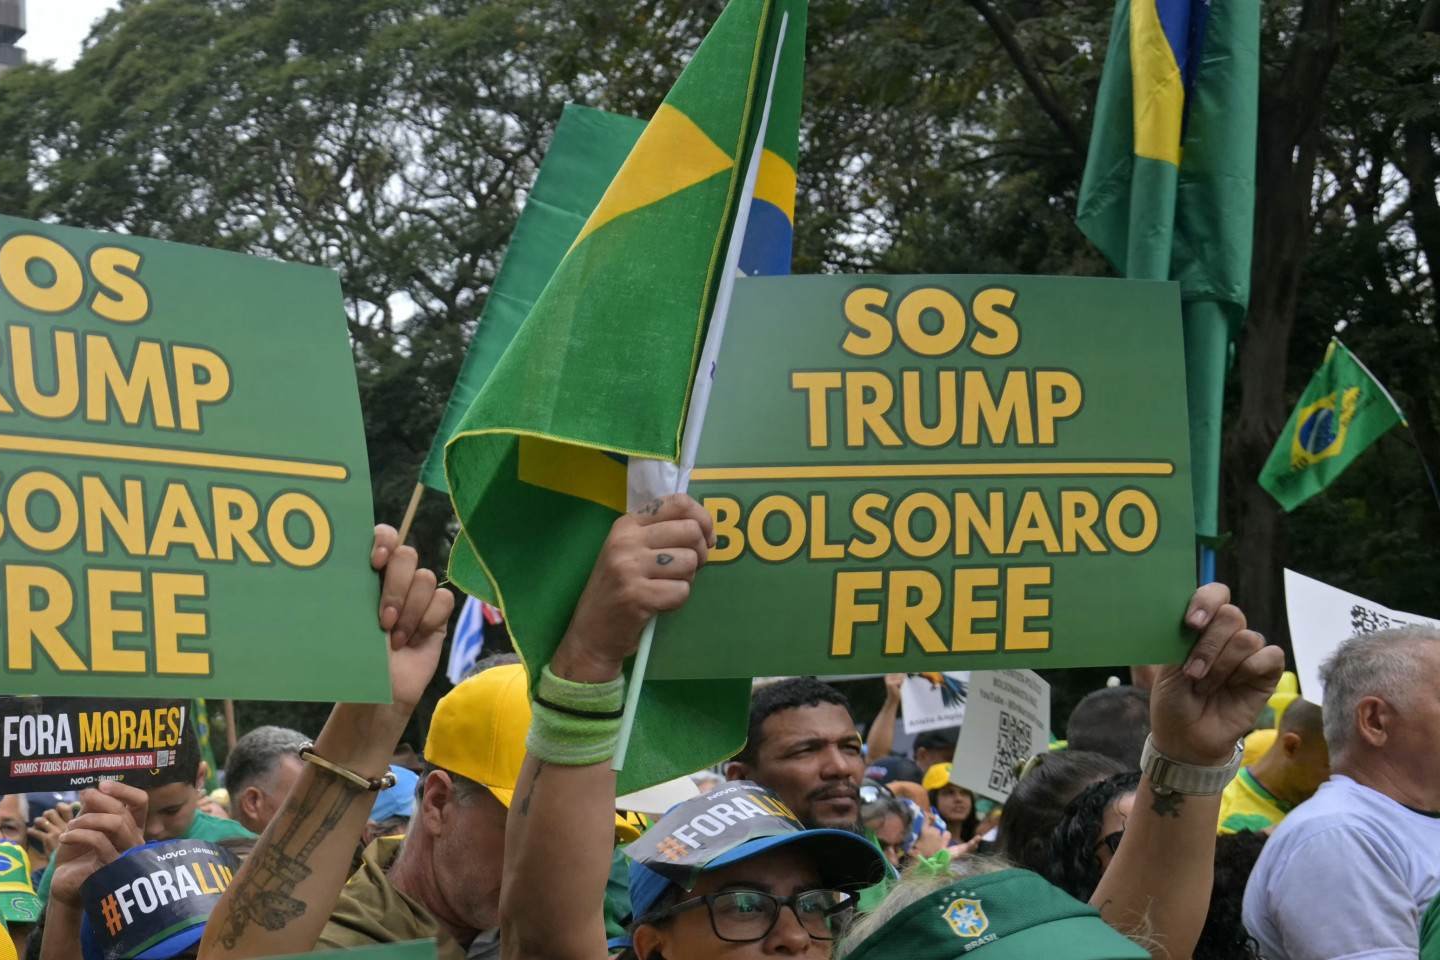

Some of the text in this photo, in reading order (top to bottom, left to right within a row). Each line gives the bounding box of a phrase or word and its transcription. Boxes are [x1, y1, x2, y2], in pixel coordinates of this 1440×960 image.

[843, 287, 1019, 356] SOS
[791, 370, 1082, 447] TRUMP
[702, 489, 1158, 562] BOLSONARO
[831, 566, 1051, 656] FREE
[3, 706, 185, 758] FORA MORAES!
[13, 762, 38, 774] SOMOS
[39, 761, 61, 773] TODOS
[62, 759, 88, 771] CONTRA
[94, 756, 125, 769] DITADURA
[125, 755, 135, 766] DA
[136, 754, 153, 766] TOGA
[70, 776, 94, 785] NOVO
[157, 849, 188, 862] NOVO
[964, 933, 1000, 951] BRASIL
